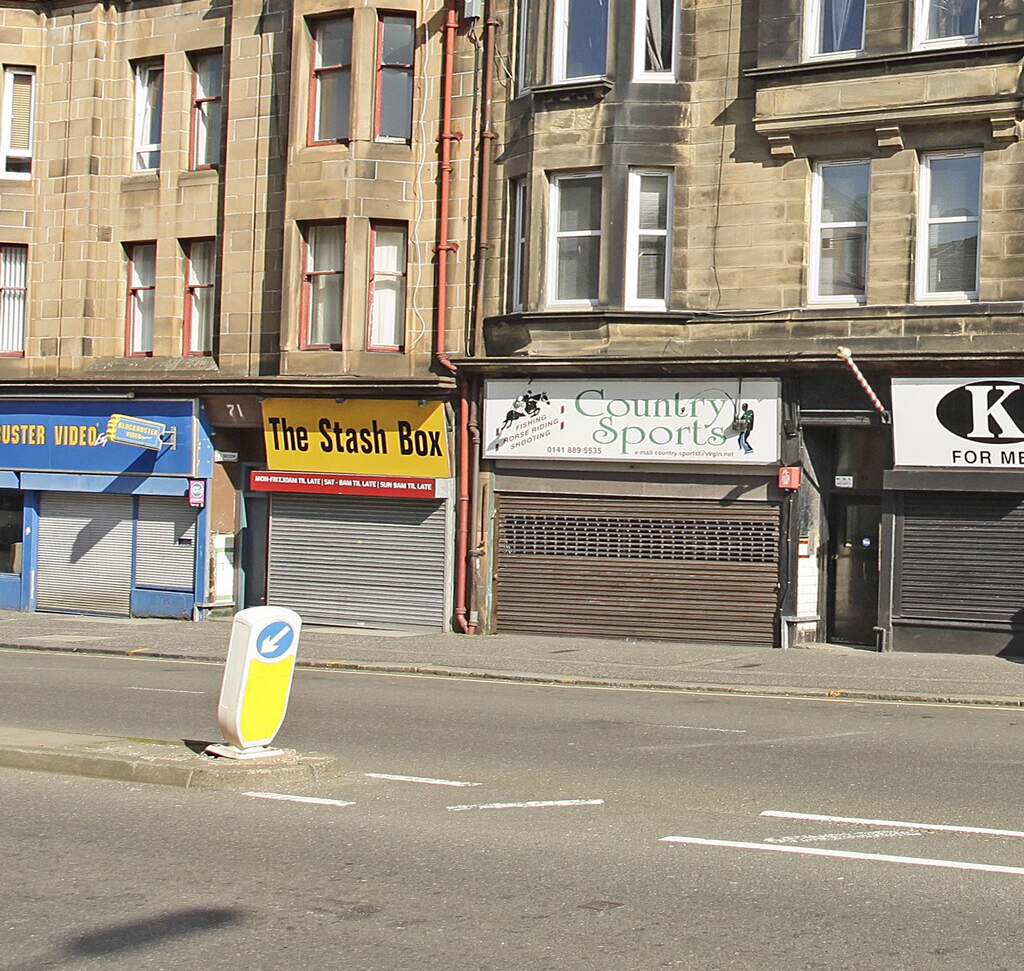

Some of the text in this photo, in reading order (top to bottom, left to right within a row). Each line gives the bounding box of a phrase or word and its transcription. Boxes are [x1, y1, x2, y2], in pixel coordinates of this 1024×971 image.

[226, 404, 243, 417] 71
[575, 389, 728, 429] Country
[504, 418, 560, 444] HORSE RIDING
[515, 414, 547, 431] FISHING
[0, 424, 97, 446] USTER VIDEO
[268, 417, 443, 457] The Stash Box
[510, 429, 551, 450] SHOOTING
[592, 415, 727, 455] Sports
[547, 446, 565, 454] 0141
[583, 447, 602, 455] 5535
[952, 450, 991, 464] FOR
